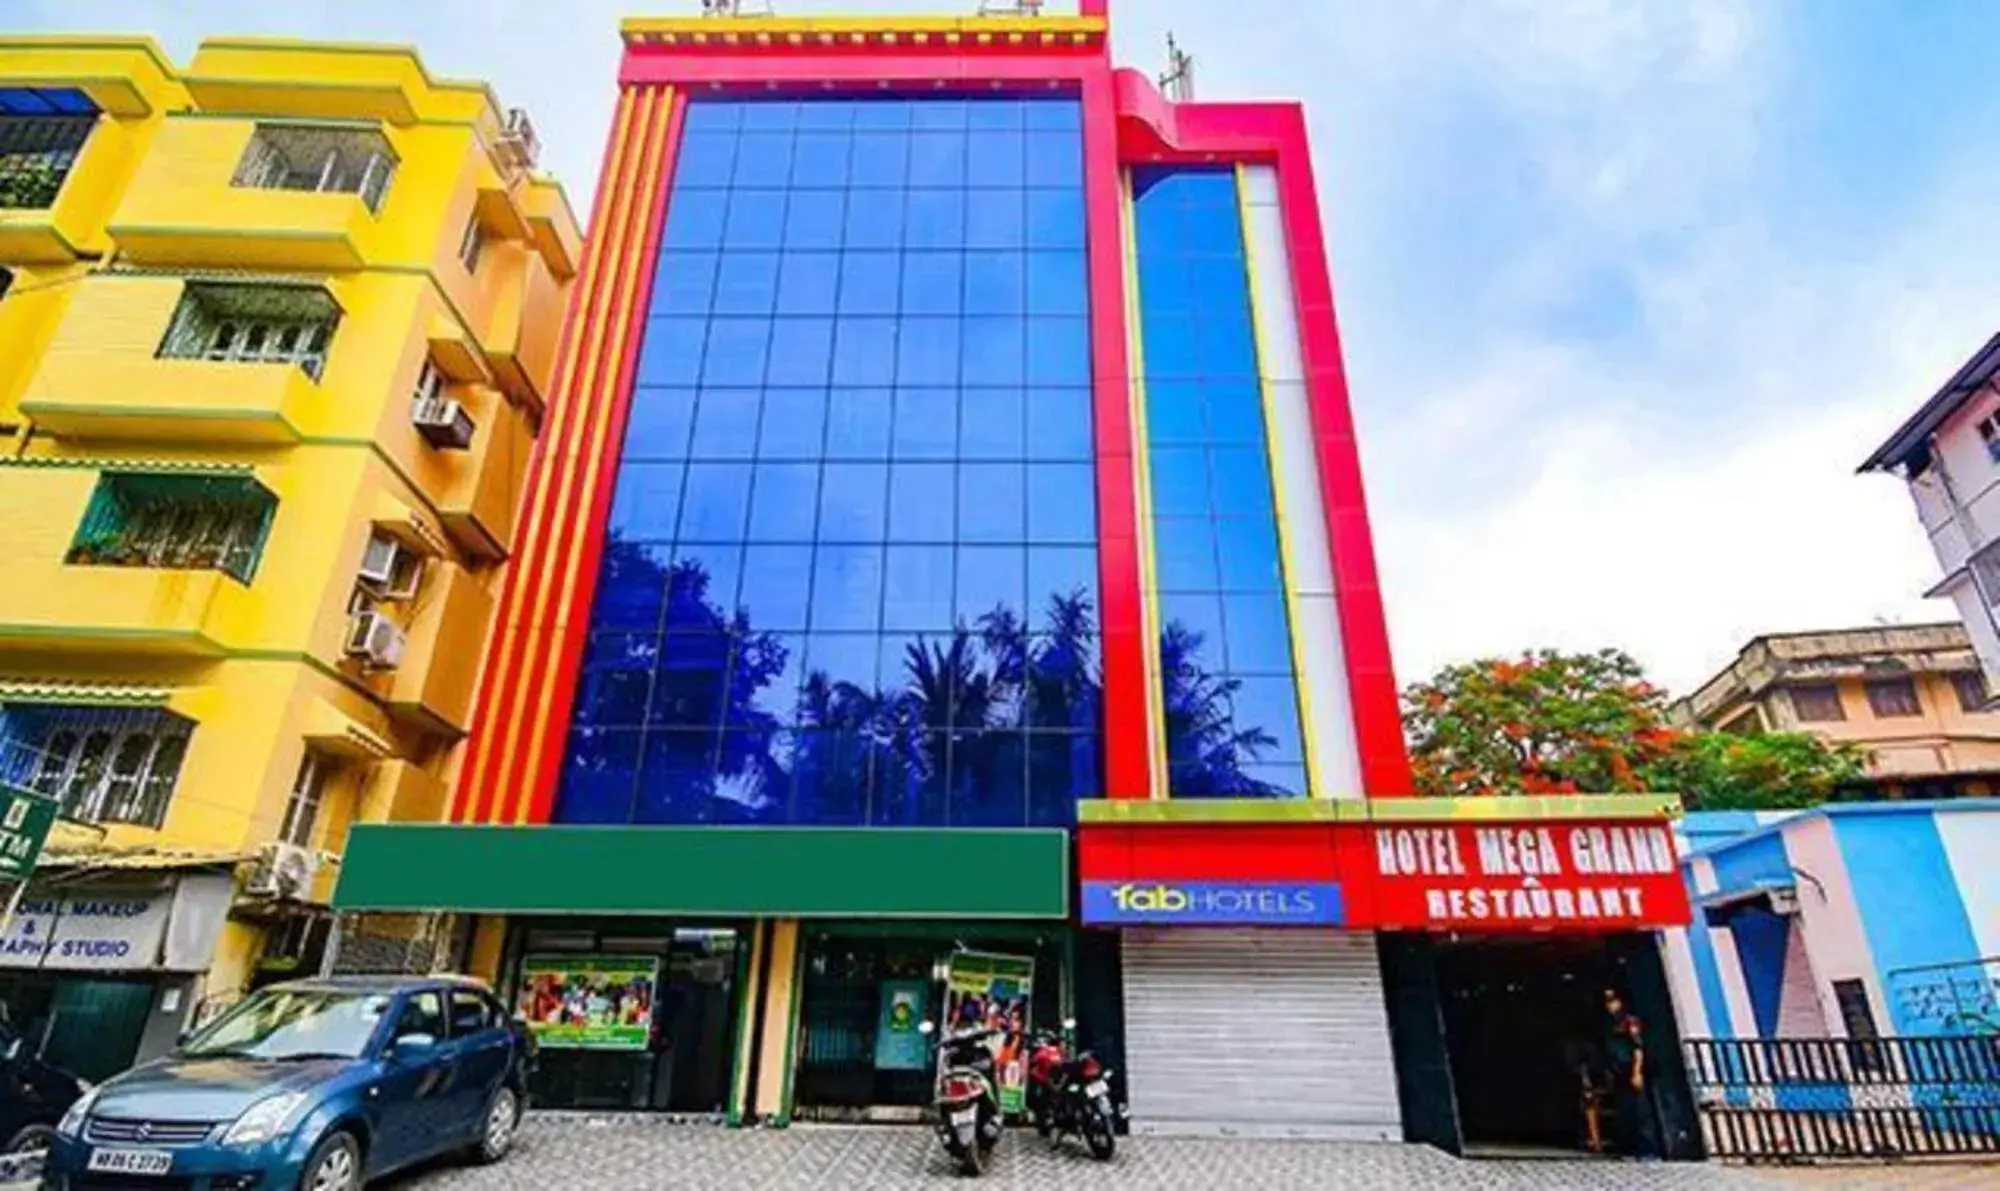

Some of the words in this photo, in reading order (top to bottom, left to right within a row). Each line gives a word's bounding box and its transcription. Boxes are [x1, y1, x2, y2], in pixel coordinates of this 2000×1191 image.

[1375, 828, 1466, 875] HOTEL
[1475, 828, 1562, 875] MEGA
[1569, 828, 1676, 875] GRAND
[71, 901, 149, 917] MAKEUP
[1425, 886, 1643, 919] RESTAURANT
[22, 919, 36, 934] &
[62, 939, 130, 957] STUDIO
